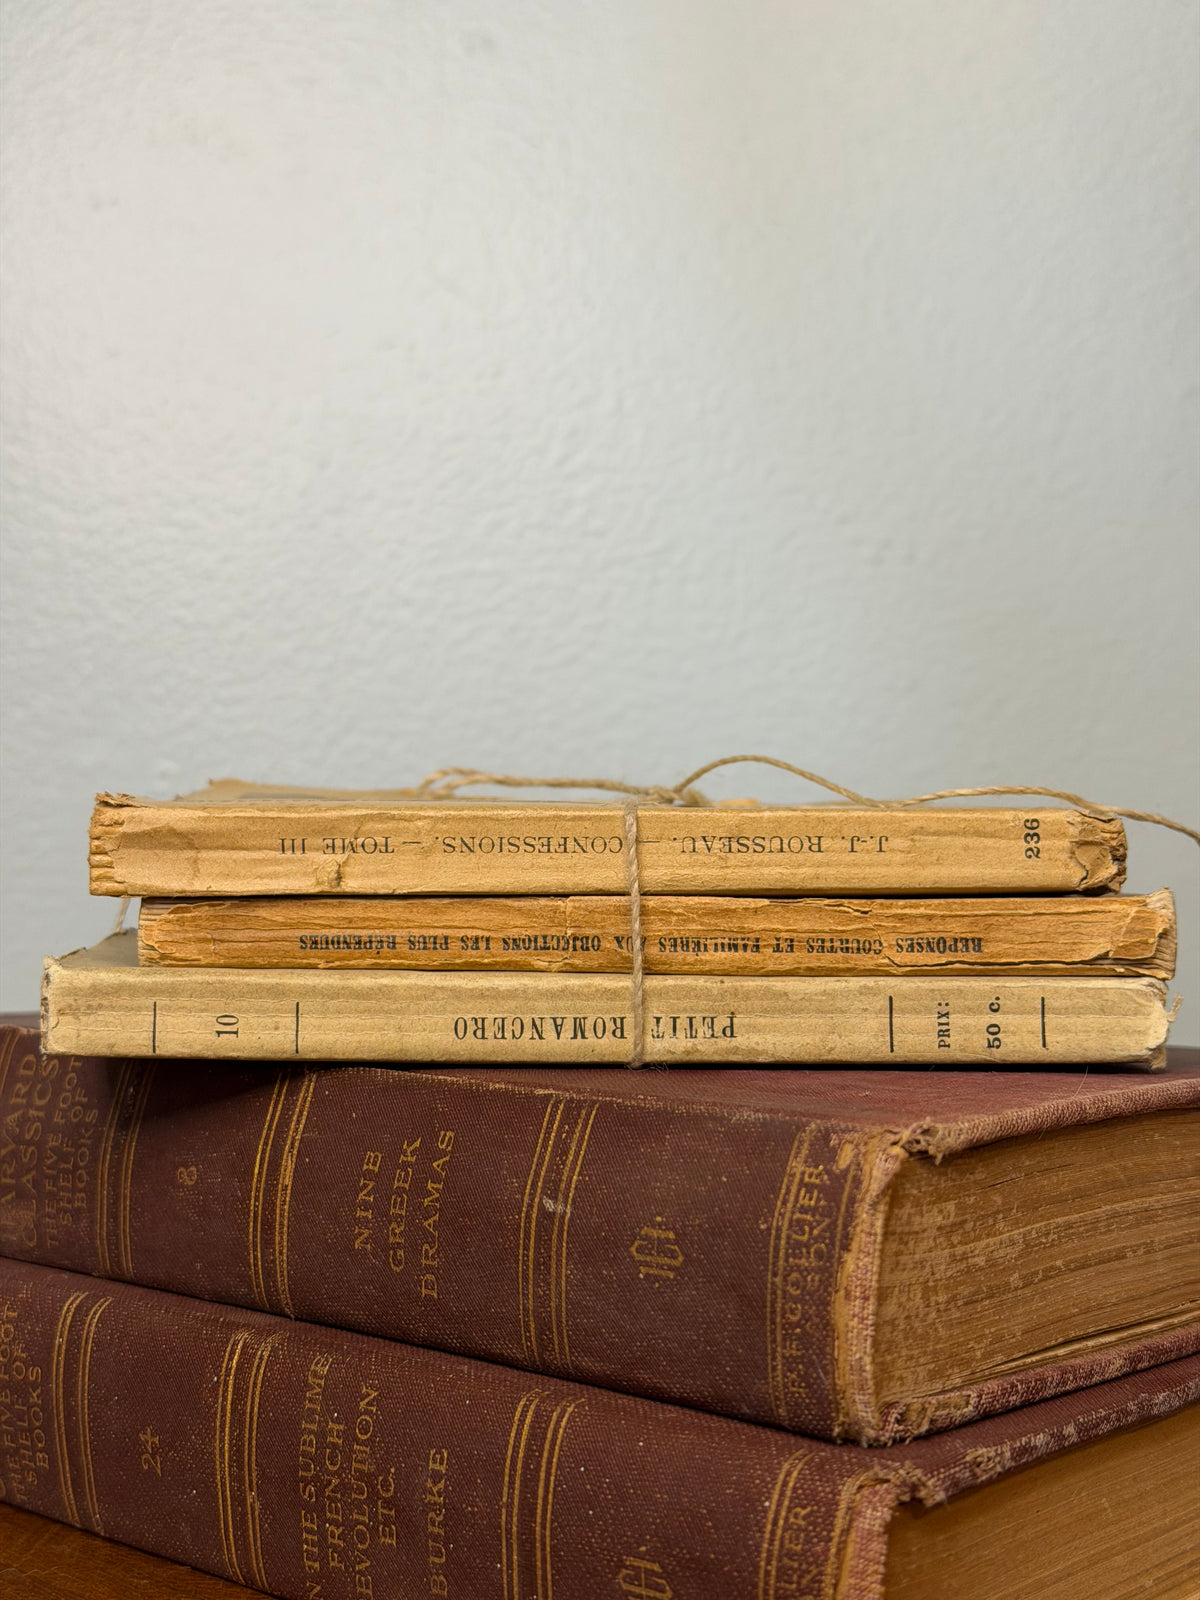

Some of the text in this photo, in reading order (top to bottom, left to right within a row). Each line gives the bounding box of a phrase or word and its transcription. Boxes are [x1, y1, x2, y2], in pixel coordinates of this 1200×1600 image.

[279, 837, 308, 855] III
[322, 836, 395, 855] TOME
[435, 836, 623, 854] CONFESSIONS.
[673, 835, 824, 853] ROUSSEAU.
[840, 835, 888, 853] J.-J.
[1023, 818, 1040, 859] 236
[408, 935, 449, 951] PLUS
[460, 935, 491, 951] LES
[502, 935, 602, 952] OBJECTIONS
[658, 936, 761, 957] FAMILIÈRES
[772, 937, 795, 953] ET
[806, 937, 883, 955] COURTES
[215, 1014, 239, 1039] 10
[454, 1015, 737, 1041] PETIT ROMANCERO
[986, 995, 1001, 1050] 50 c.
[22, 1058, 59, 1249] CLASSICS
[44, 1057, 83, 1248] THE FIVE FOOT
[59, 1087, 89, 1226] SHELF OF
[75, 1108, 99, 1209] BOOKS
[177, 1165, 197, 1187] 8
[388, 1136, 422, 1273] GREEK
[421, 1130, 455, 1300] DRAMAS
[12, 1340, 38, 1486] SHELF OF
[29, 1365, 50, 1470] BOOKS
[300, 1354, 333, 1502] SUBLIME
[139, 1425, 162, 1478] 24
[9, 1455, 27, 1502] THE
[325, 1420, 345, 1571] FRENCH
[351, 1383, 380, 1600] EVOLUTION
[377, 1466, 397, 1548] ETC.
[427, 1449, 449, 1598] BURKE
[301, 1510, 320, 1574] THE
